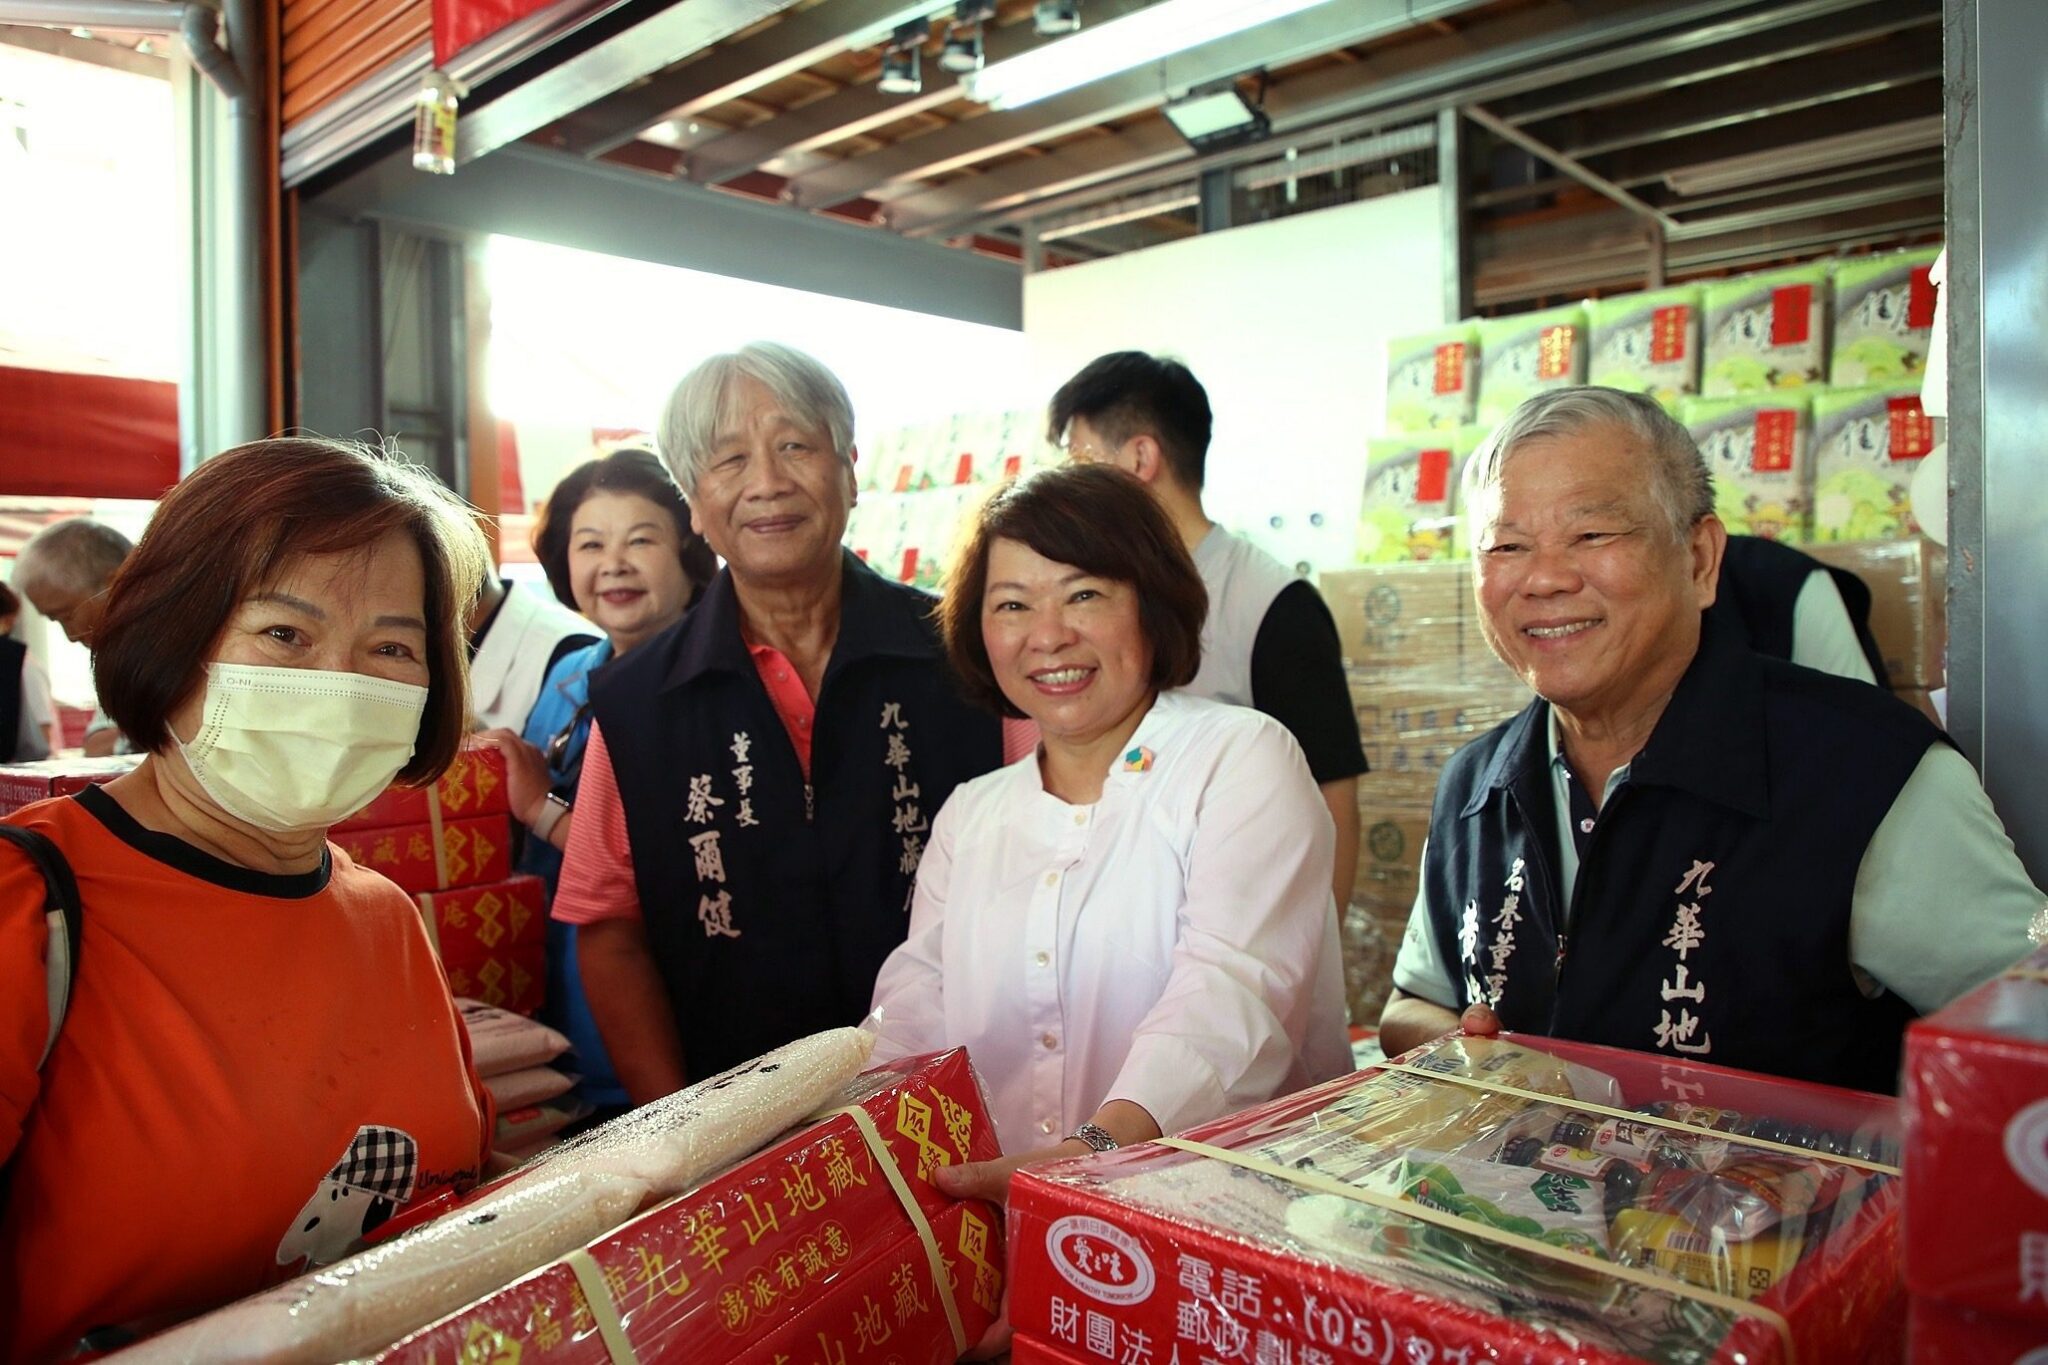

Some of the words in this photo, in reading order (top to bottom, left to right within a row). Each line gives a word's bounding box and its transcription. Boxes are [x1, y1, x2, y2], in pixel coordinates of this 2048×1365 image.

[730, 731, 759, 827] 董事長
[880, 702, 928, 912] 九華山地藏
[684, 774, 742, 938] 蔡爾健
[1652, 859, 1716, 1054] 九華山地
[720, 1225, 849, 1329] 澎派有誠意
[1051, 1296, 1228, 1365] 財團法人
